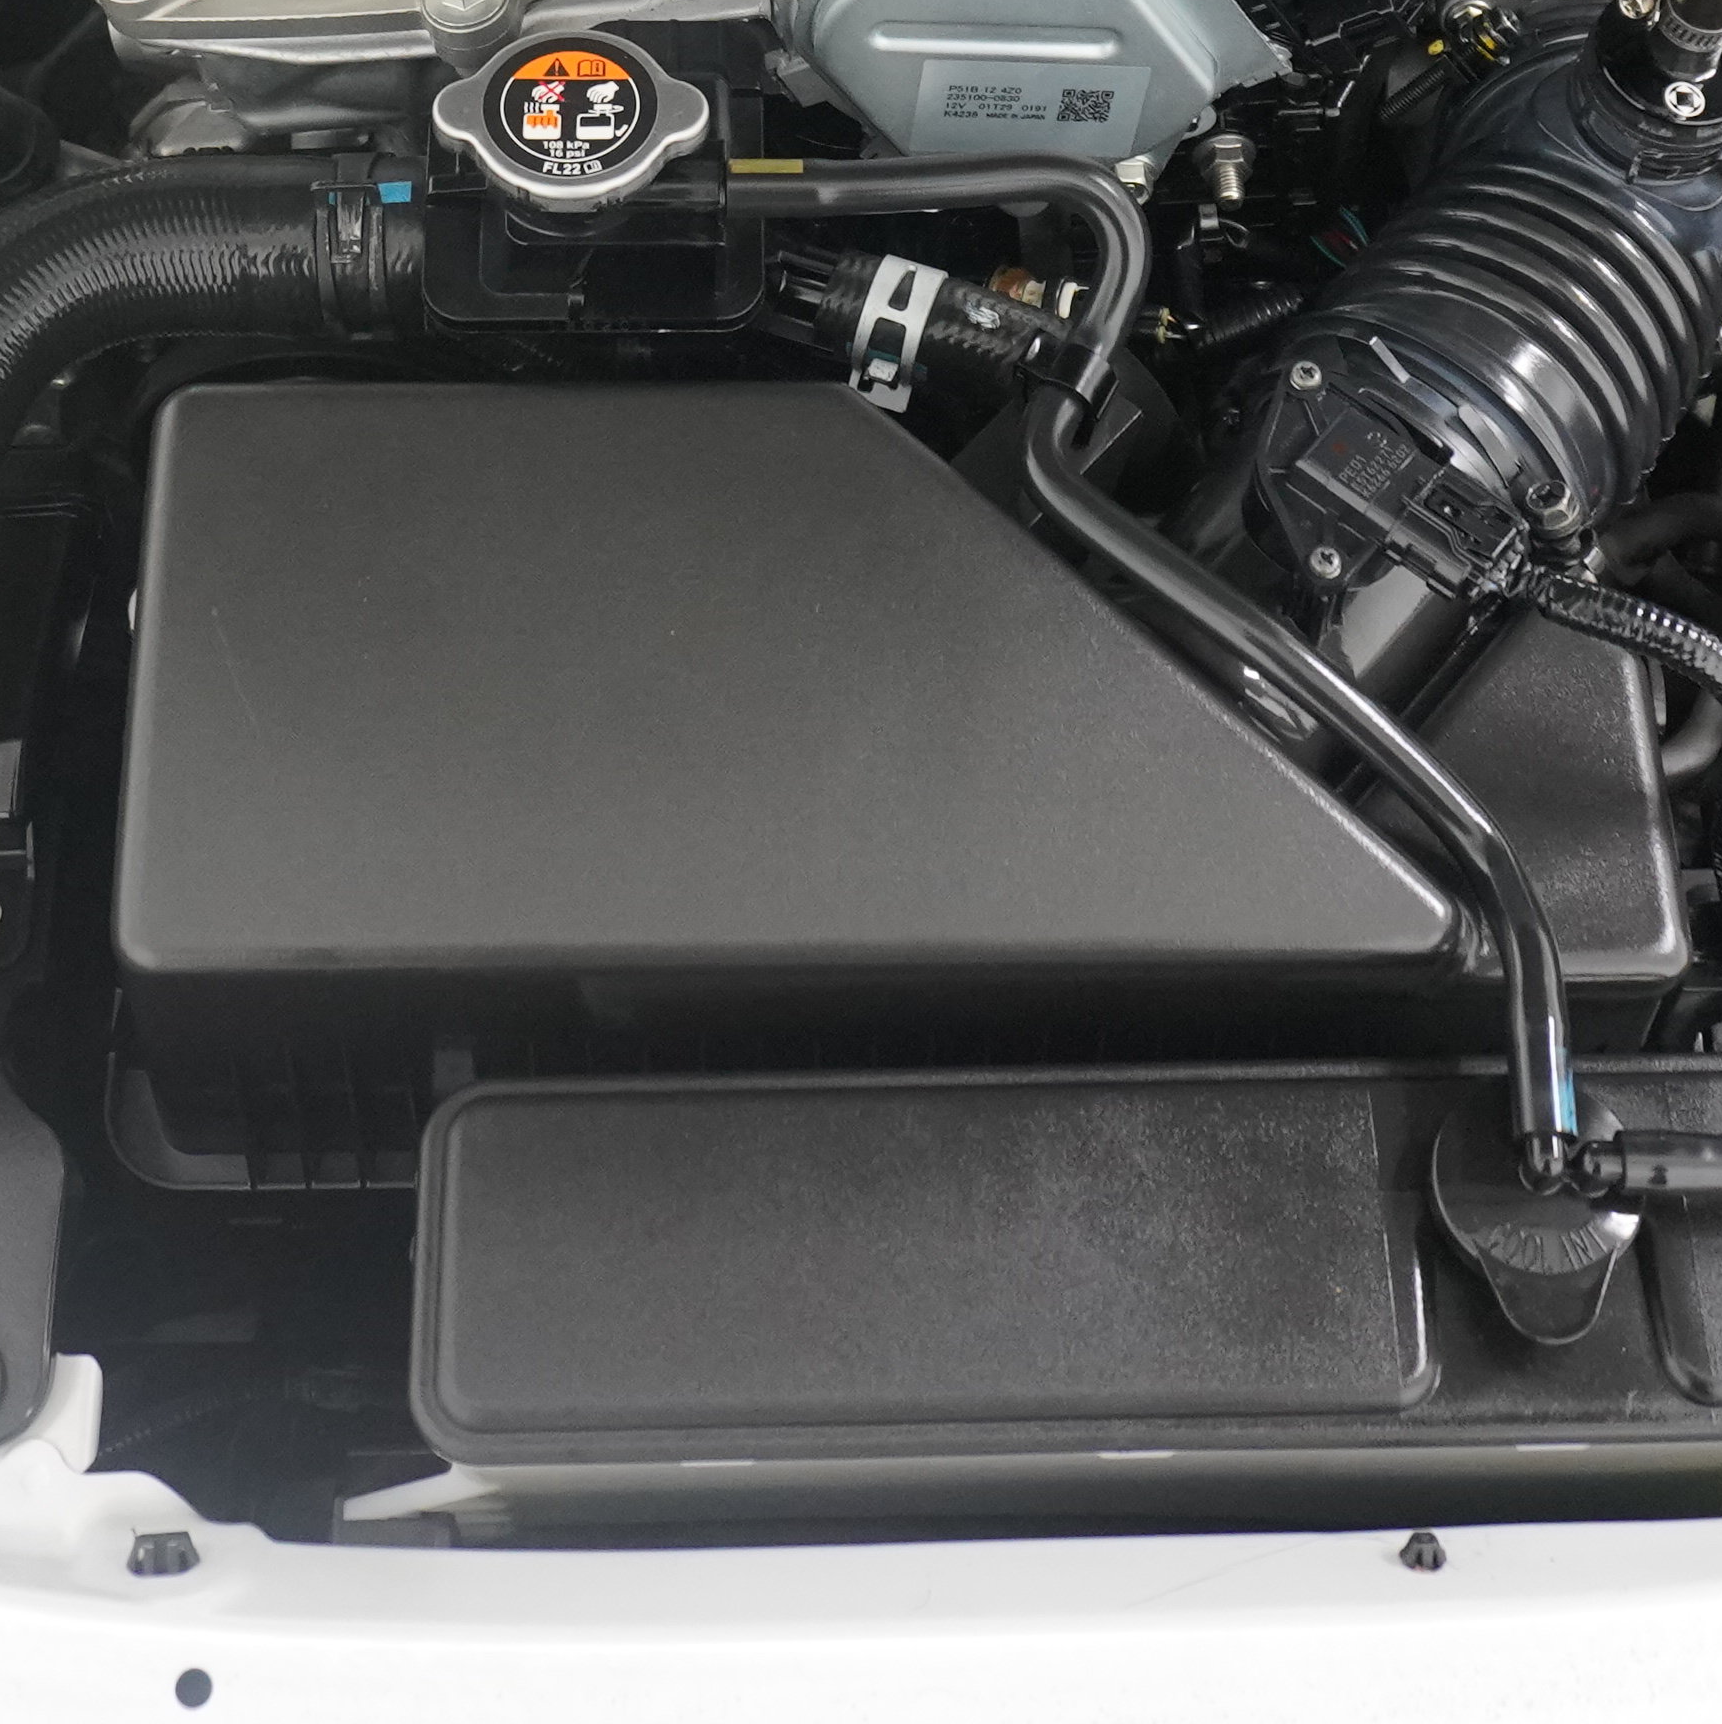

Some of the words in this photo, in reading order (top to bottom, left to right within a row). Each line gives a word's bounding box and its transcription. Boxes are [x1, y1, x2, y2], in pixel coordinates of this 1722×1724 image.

[945, 102, 967, 110] 12V
[985, 112, 1010, 120] MADE
[1020, 113, 1046, 121] JAPAN
[543, 140, 564, 150] 108
[566, 140, 590, 150] kPa
[549, 149, 564, 158] 16
[565, 149, 586, 159] psi
[542, 161, 582, 175] FL22
